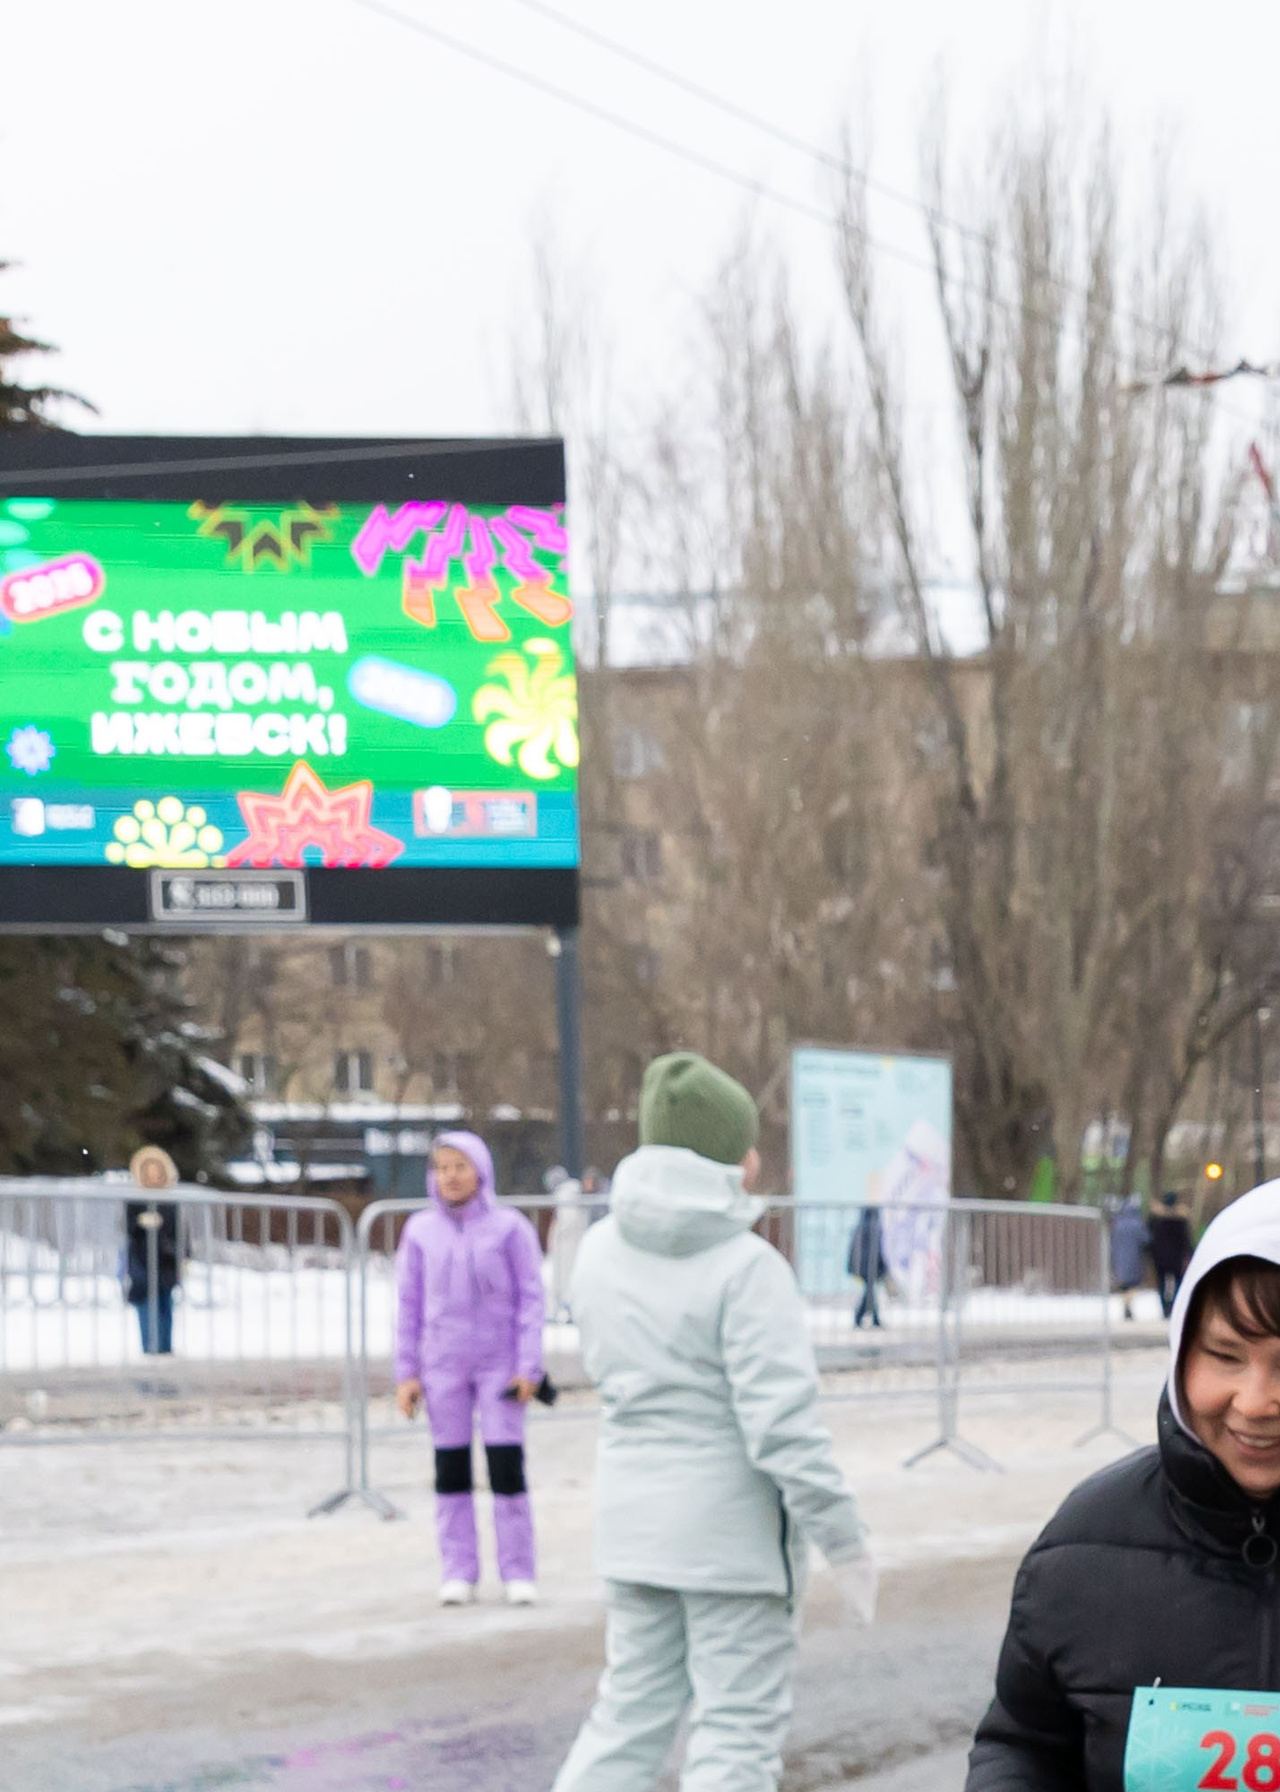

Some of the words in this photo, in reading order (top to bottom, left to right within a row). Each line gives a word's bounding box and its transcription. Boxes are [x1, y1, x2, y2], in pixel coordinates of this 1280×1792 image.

[82, 609, 125, 652] С
[132, 609, 349, 654] НОВЫМ
[110, 660, 334, 711] ГОДОМ,
[90, 711, 348, 756] ИЖЕВСК!
